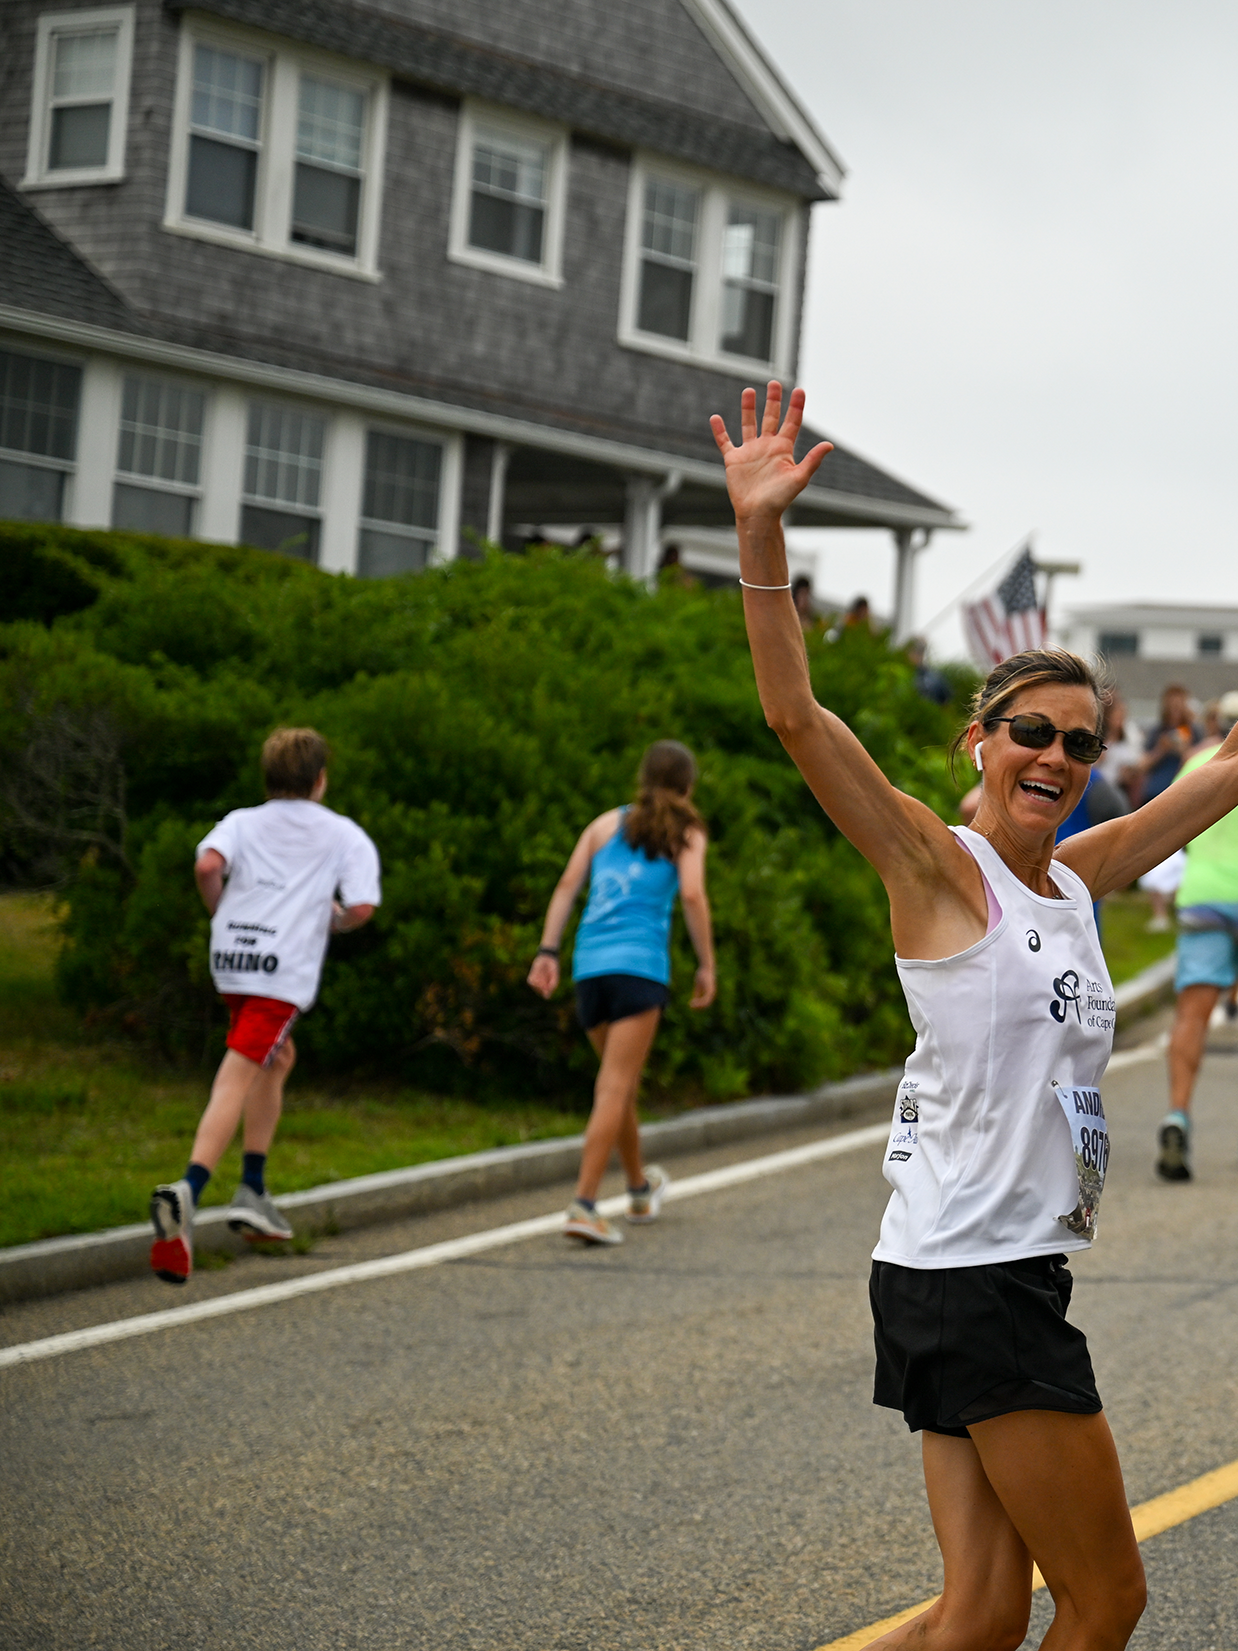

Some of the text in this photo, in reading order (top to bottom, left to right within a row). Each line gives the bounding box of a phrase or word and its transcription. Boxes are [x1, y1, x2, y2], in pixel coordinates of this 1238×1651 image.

[213, 951, 278, 973] RHINO
[1086, 979, 1103, 993] Arts
[1087, 1015, 1096, 1028] of
